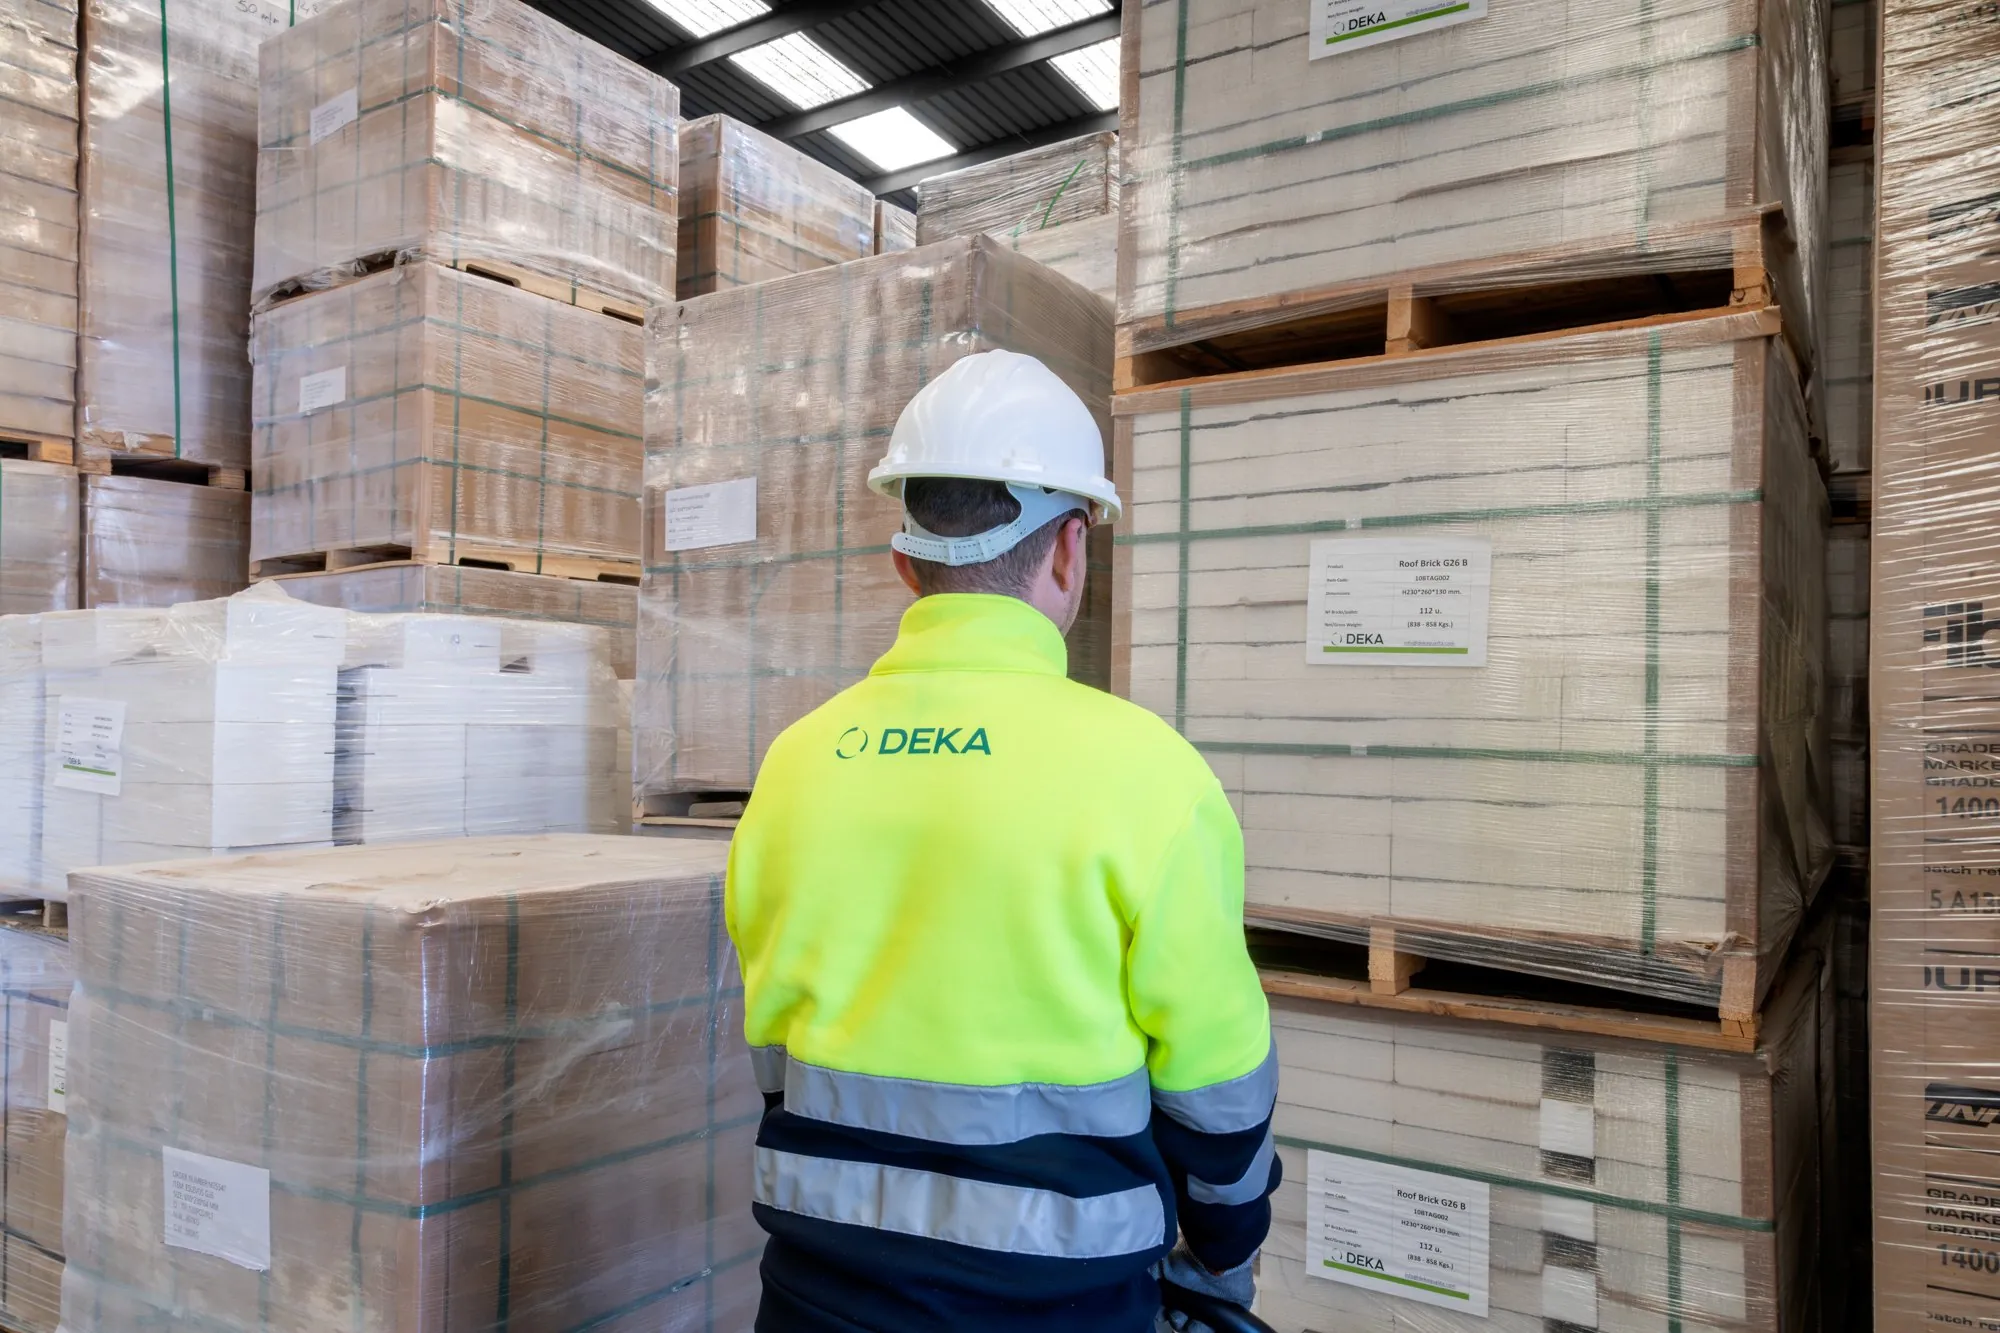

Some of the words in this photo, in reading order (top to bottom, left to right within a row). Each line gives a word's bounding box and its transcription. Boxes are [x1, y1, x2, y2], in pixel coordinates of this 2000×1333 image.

[1348, 11, 1386, 31] DEKA
[1399, 559, 1419, 568] Roof
[1420, 559, 1441, 568] Brick
[1443, 559, 1460, 567] G26
[1462, 558, 1468, 567] B
[1346, 633, 1384, 645] DEKA
[878, 727, 991, 755] DEKA
[1397, 1189, 1417, 1200] Roof
[1418, 1193, 1439, 1205] Brick
[1441, 1198, 1458, 1209] G26
[1460, 1202, 1466, 1210] B
[1926, 1188, 2000, 1208] GRADE
[1419, 1242, 1433, 1252] 112
[1346, 1251, 1385, 1272] DEKA
[1425, 1256, 1438, 1266] 858
[1937, 1243, 2000, 1274] 1400
